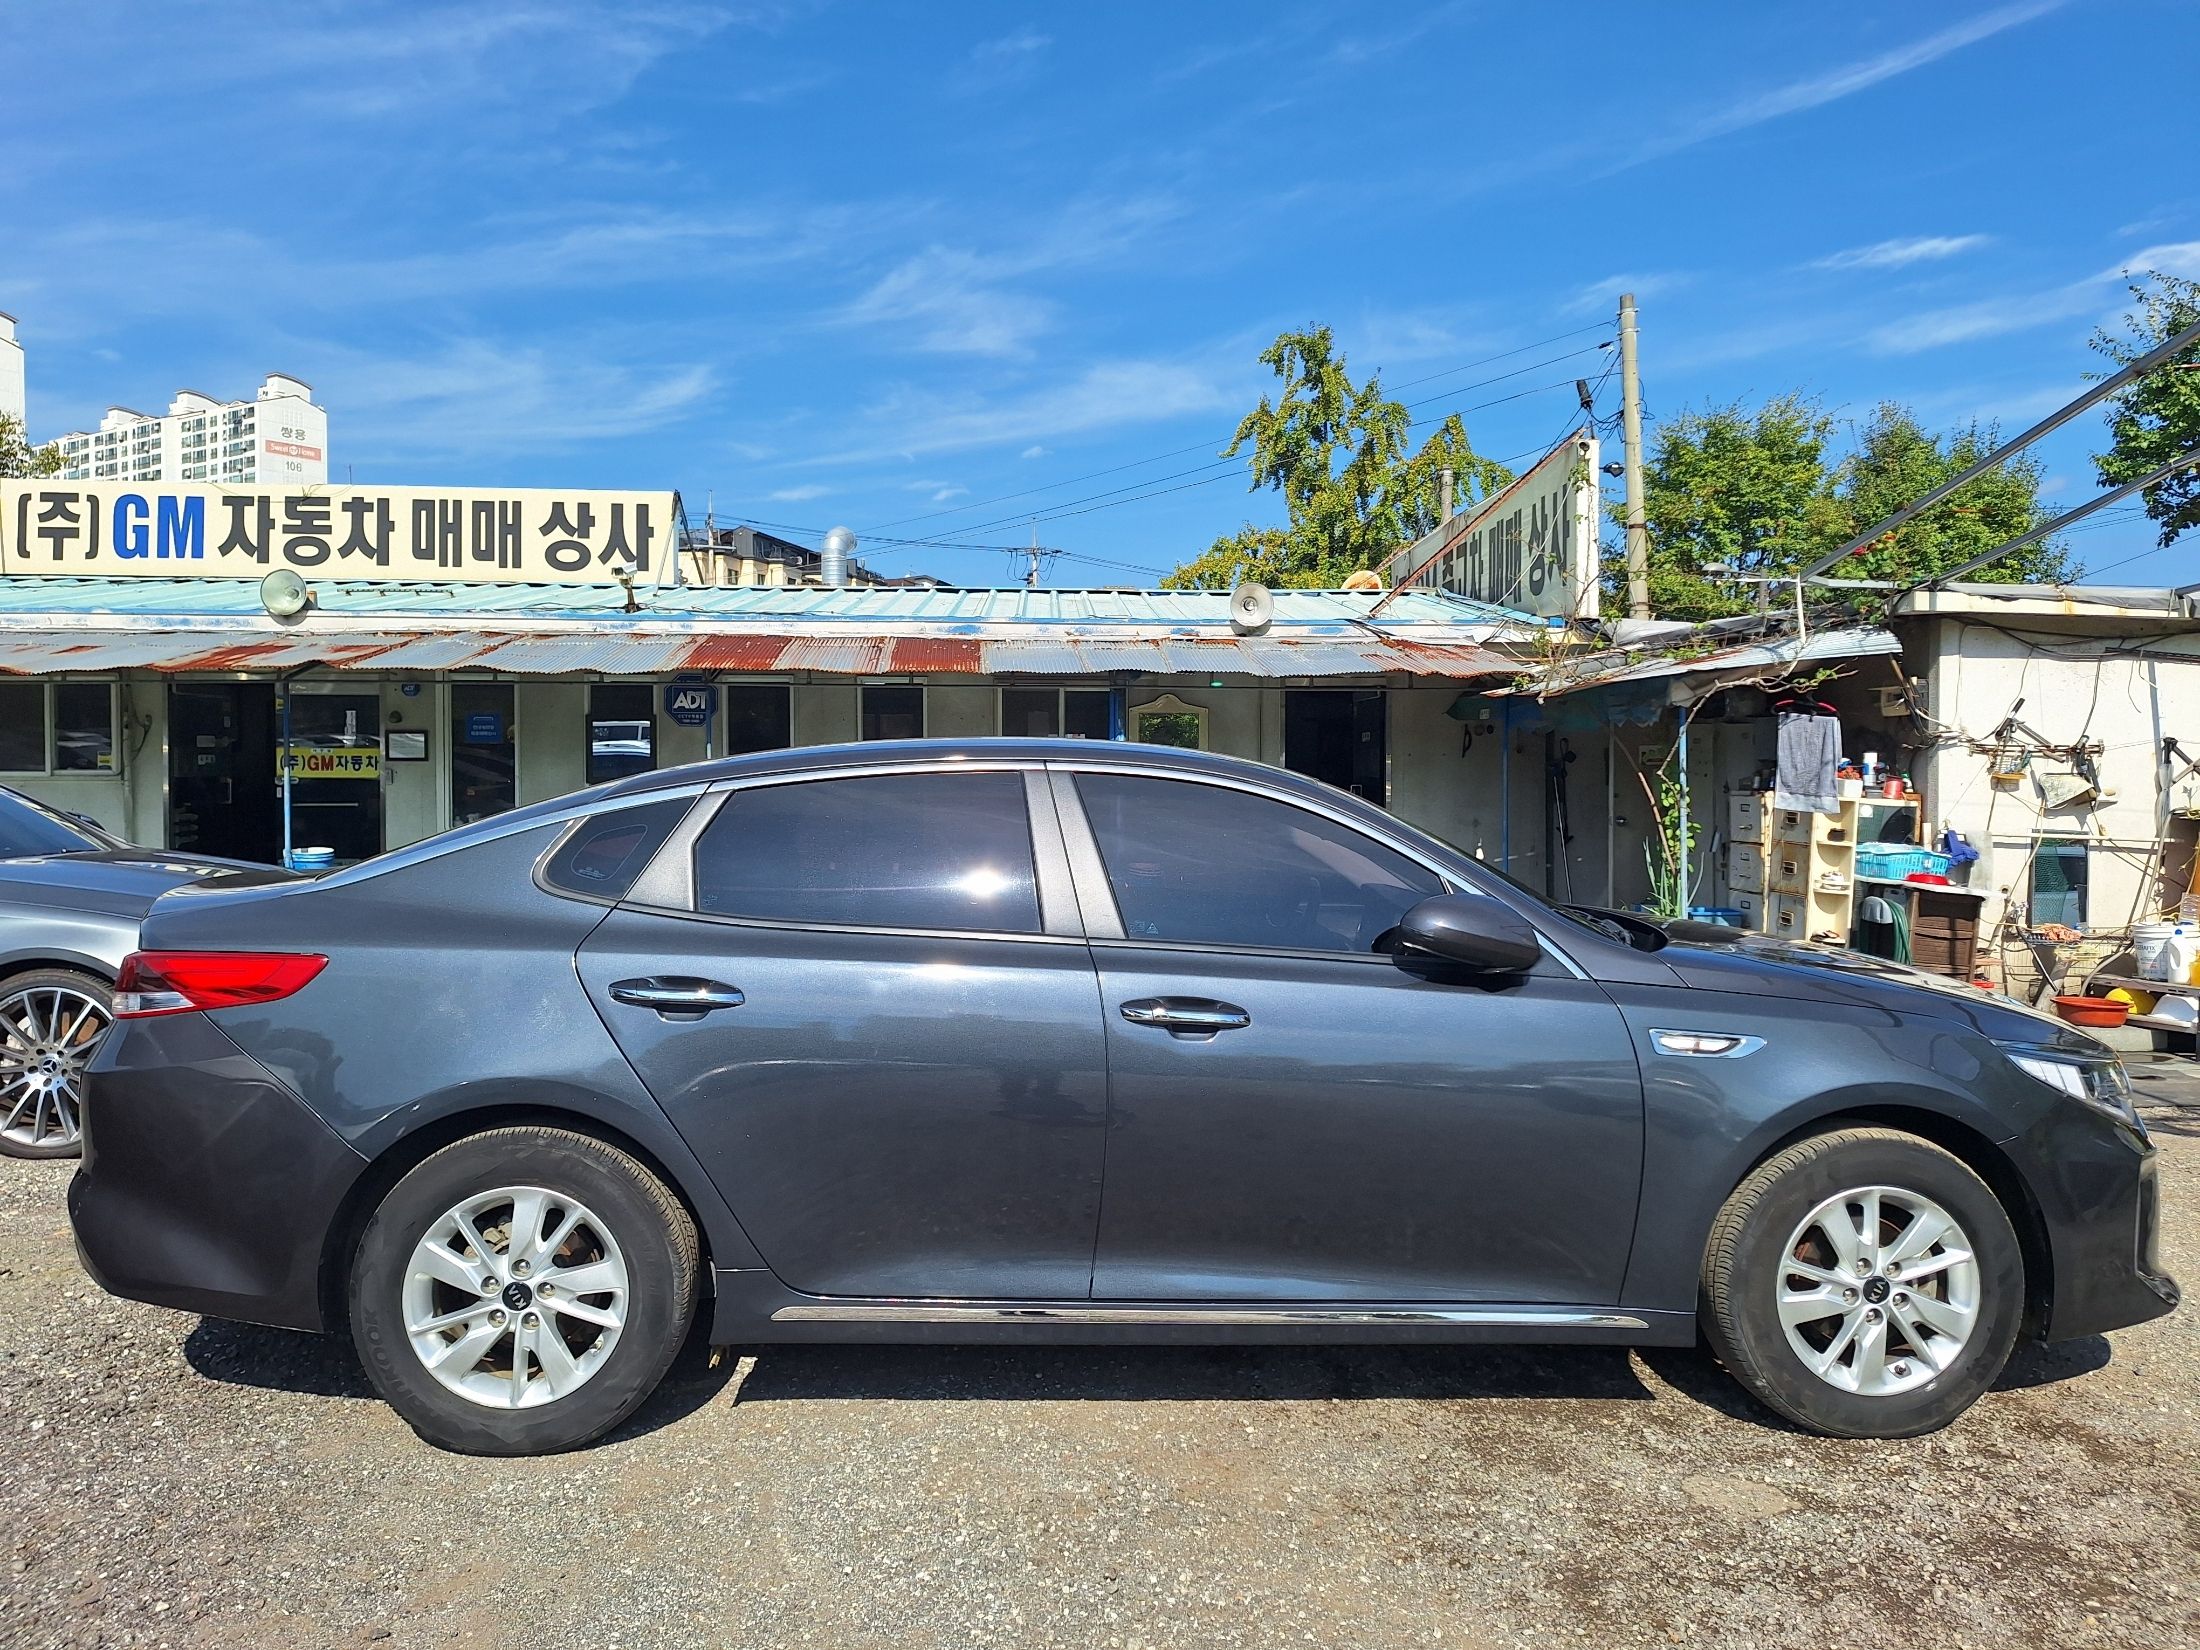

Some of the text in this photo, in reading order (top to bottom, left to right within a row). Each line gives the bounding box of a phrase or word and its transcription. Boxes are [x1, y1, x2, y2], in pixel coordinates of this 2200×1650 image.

[218, 495, 395, 567] 자동차
[411, 500, 521, 569] 매매
[538, 500, 654, 572] 상사
[673, 691, 706, 709] ADT
[508, 1284, 527, 1309] KIA
[1868, 1281, 1887, 1302] KIA
